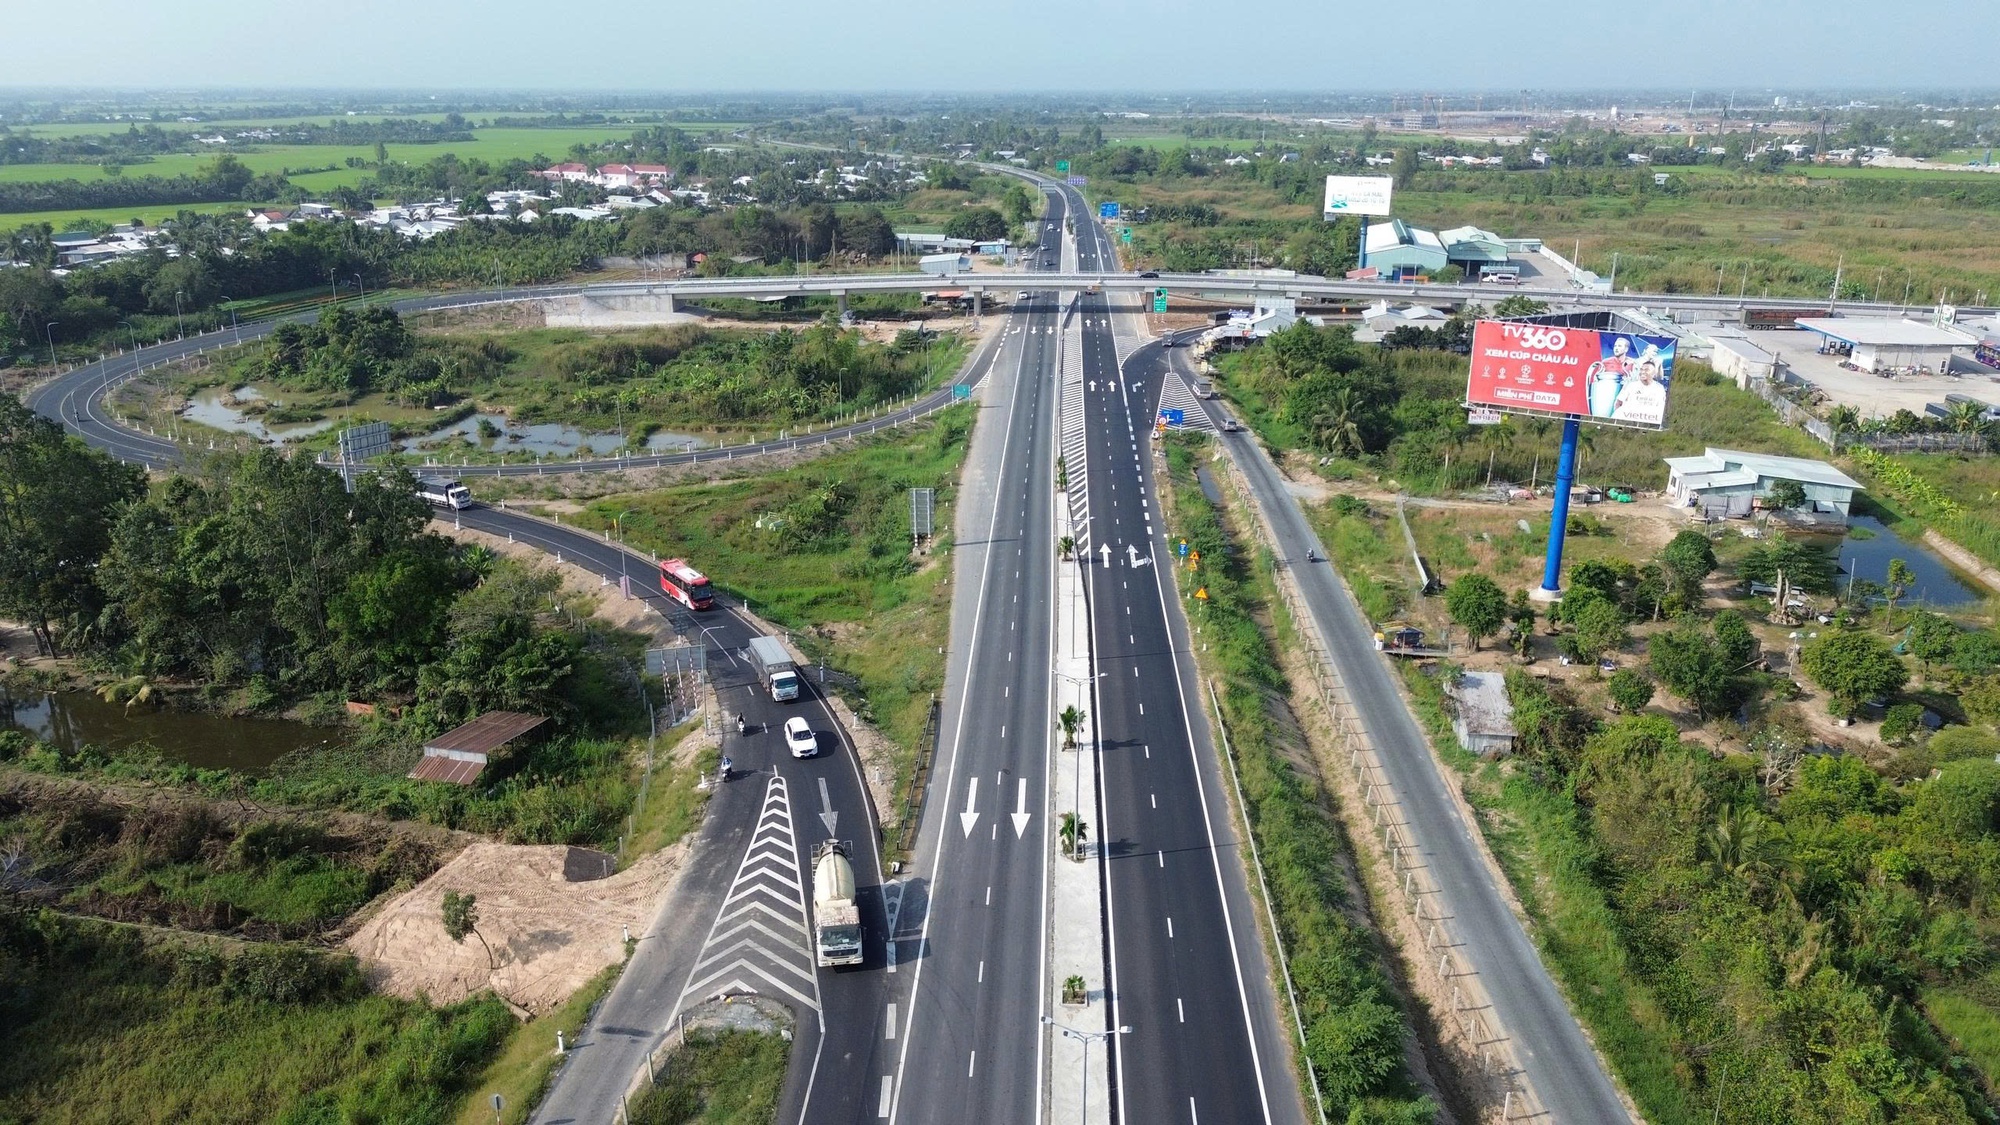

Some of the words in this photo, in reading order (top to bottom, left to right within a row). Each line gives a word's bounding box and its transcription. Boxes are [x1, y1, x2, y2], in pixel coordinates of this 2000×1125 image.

[1502, 325, 1566, 351] TV360
[1485, 349, 1508, 358] XEM
[1509, 350, 1531, 360] CÚP
[1532, 354, 1561, 363] CHÂU
[1562, 354, 1578, 365] ÂU
[1517, 391, 1533, 400] PHÍ
[1535, 394, 1557, 402] DATA
[1623, 411, 1658, 421] viettel
